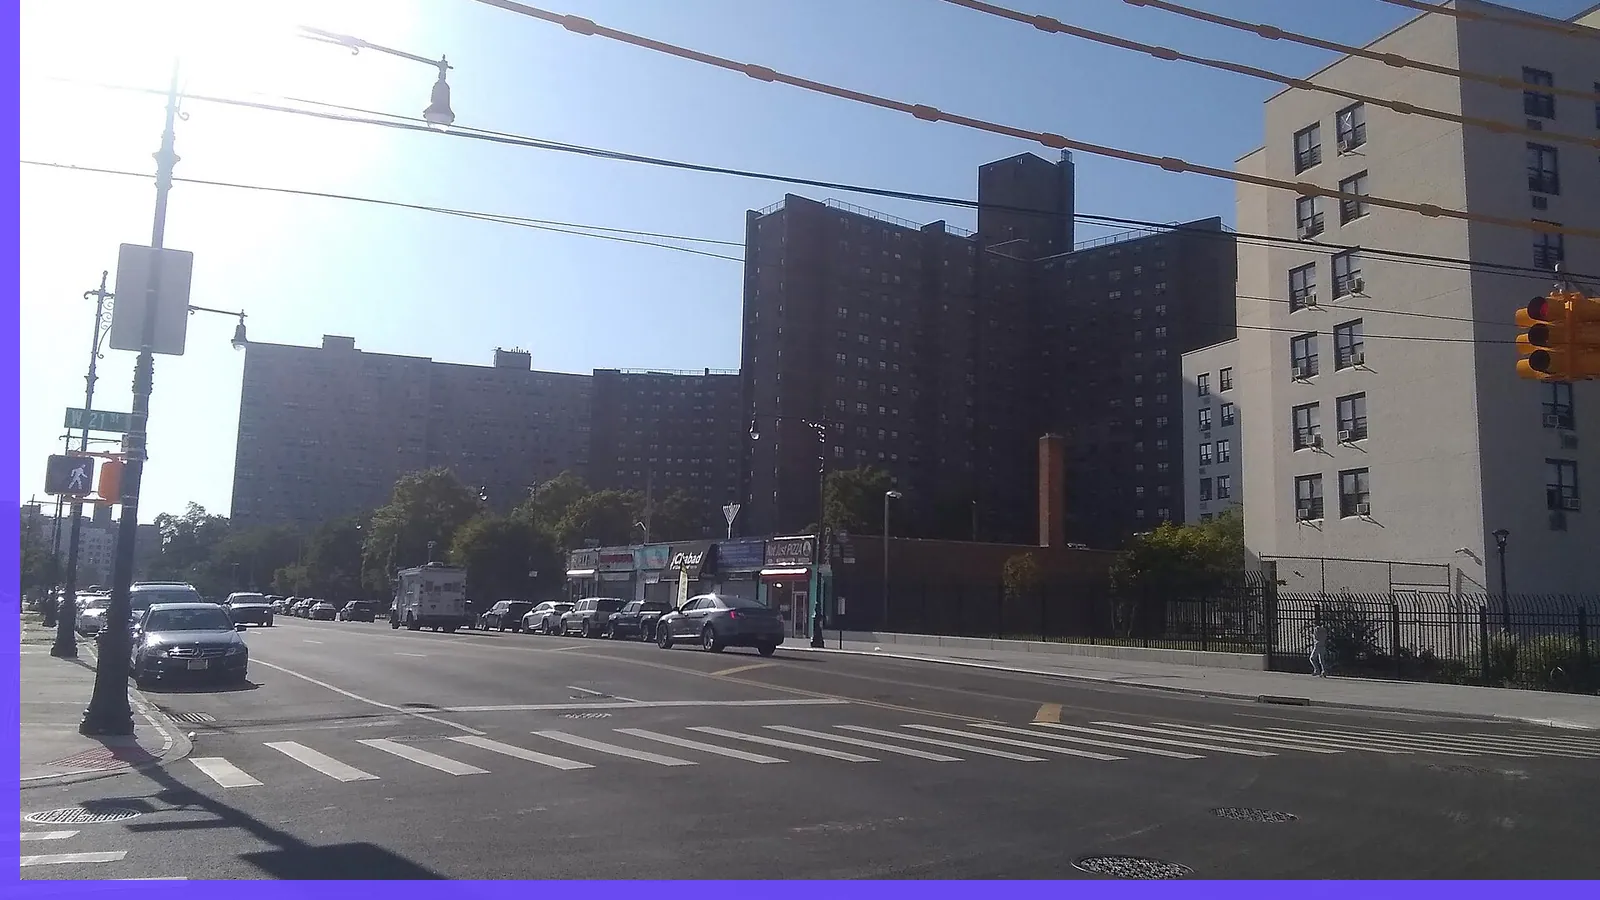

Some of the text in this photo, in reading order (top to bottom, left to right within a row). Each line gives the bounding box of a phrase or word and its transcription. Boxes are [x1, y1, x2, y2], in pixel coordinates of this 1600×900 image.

[72, 410, 83, 427] W
[89, 412, 105, 429] 21
[786, 543, 802, 556] PIZZA
